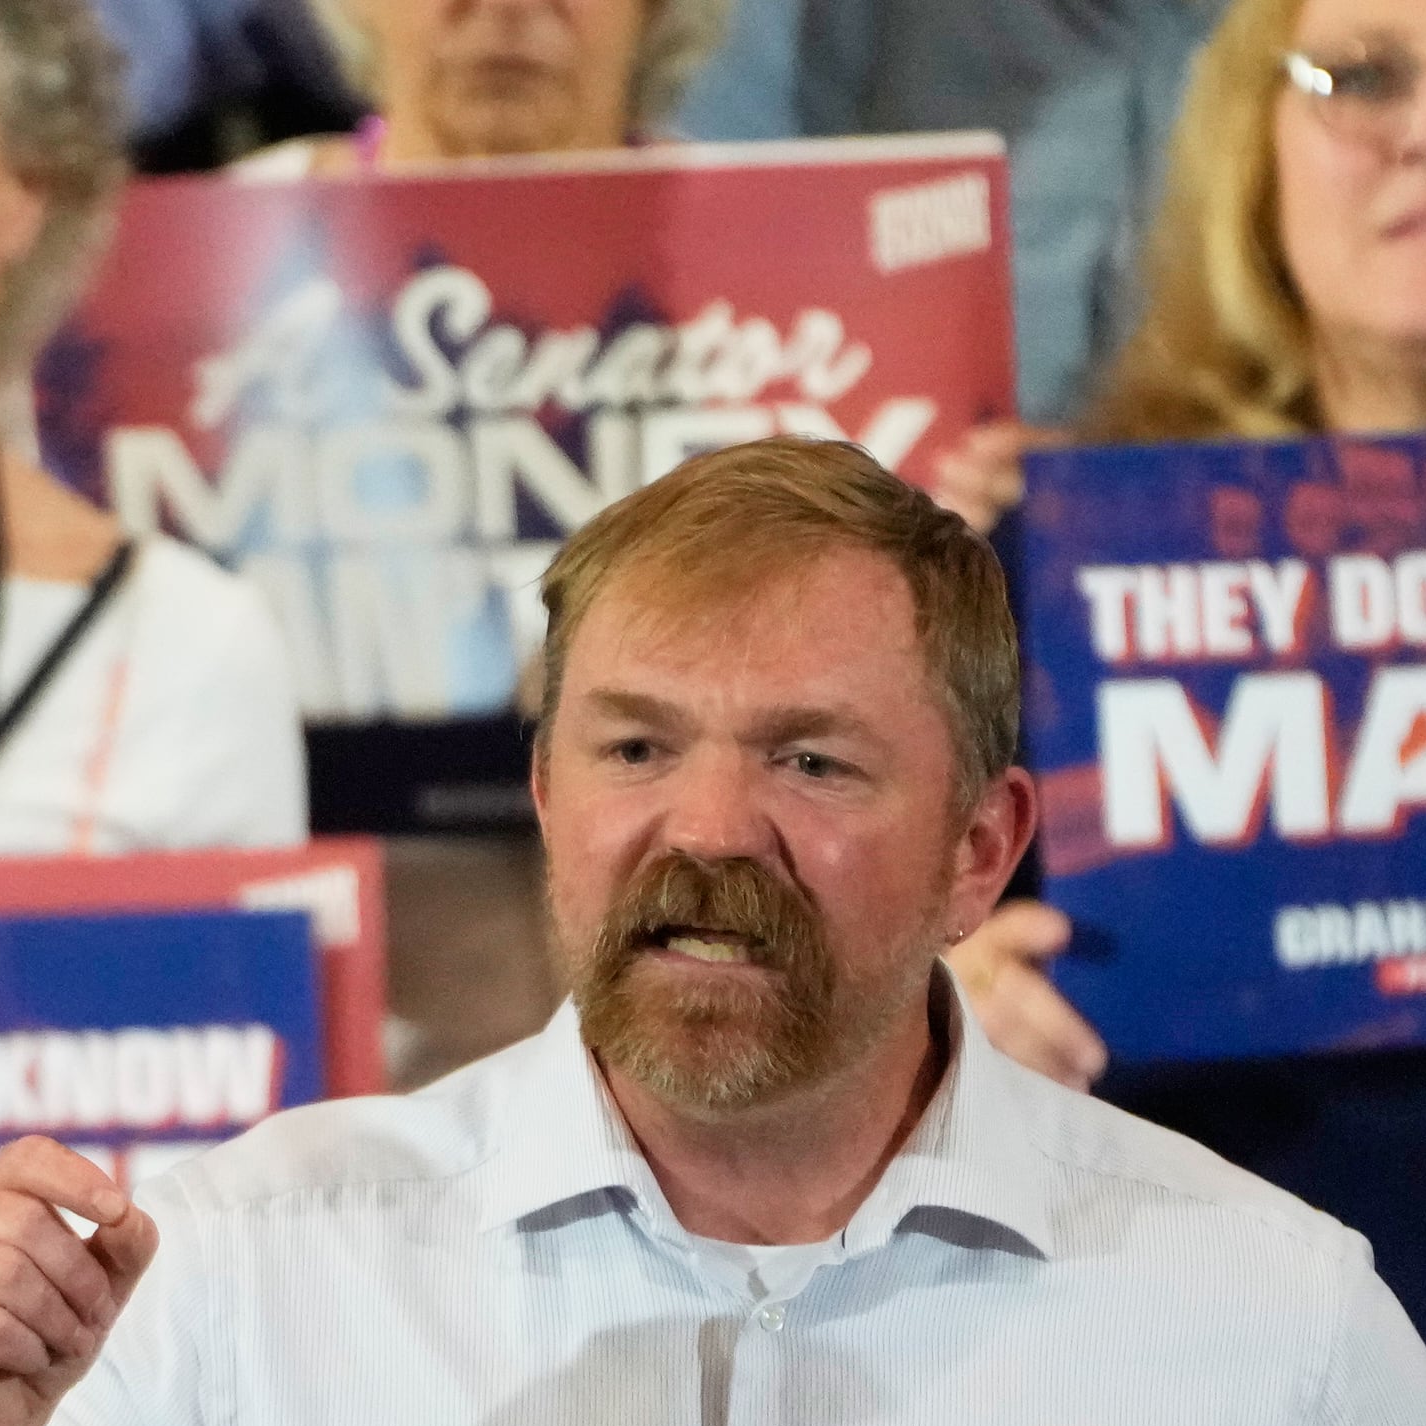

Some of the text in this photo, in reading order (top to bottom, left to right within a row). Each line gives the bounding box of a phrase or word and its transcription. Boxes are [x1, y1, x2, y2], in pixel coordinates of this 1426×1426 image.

[394, 264, 873, 415] Senator
[109, 396, 938, 547] MON
[1077, 557, 1315, 664] THEY
